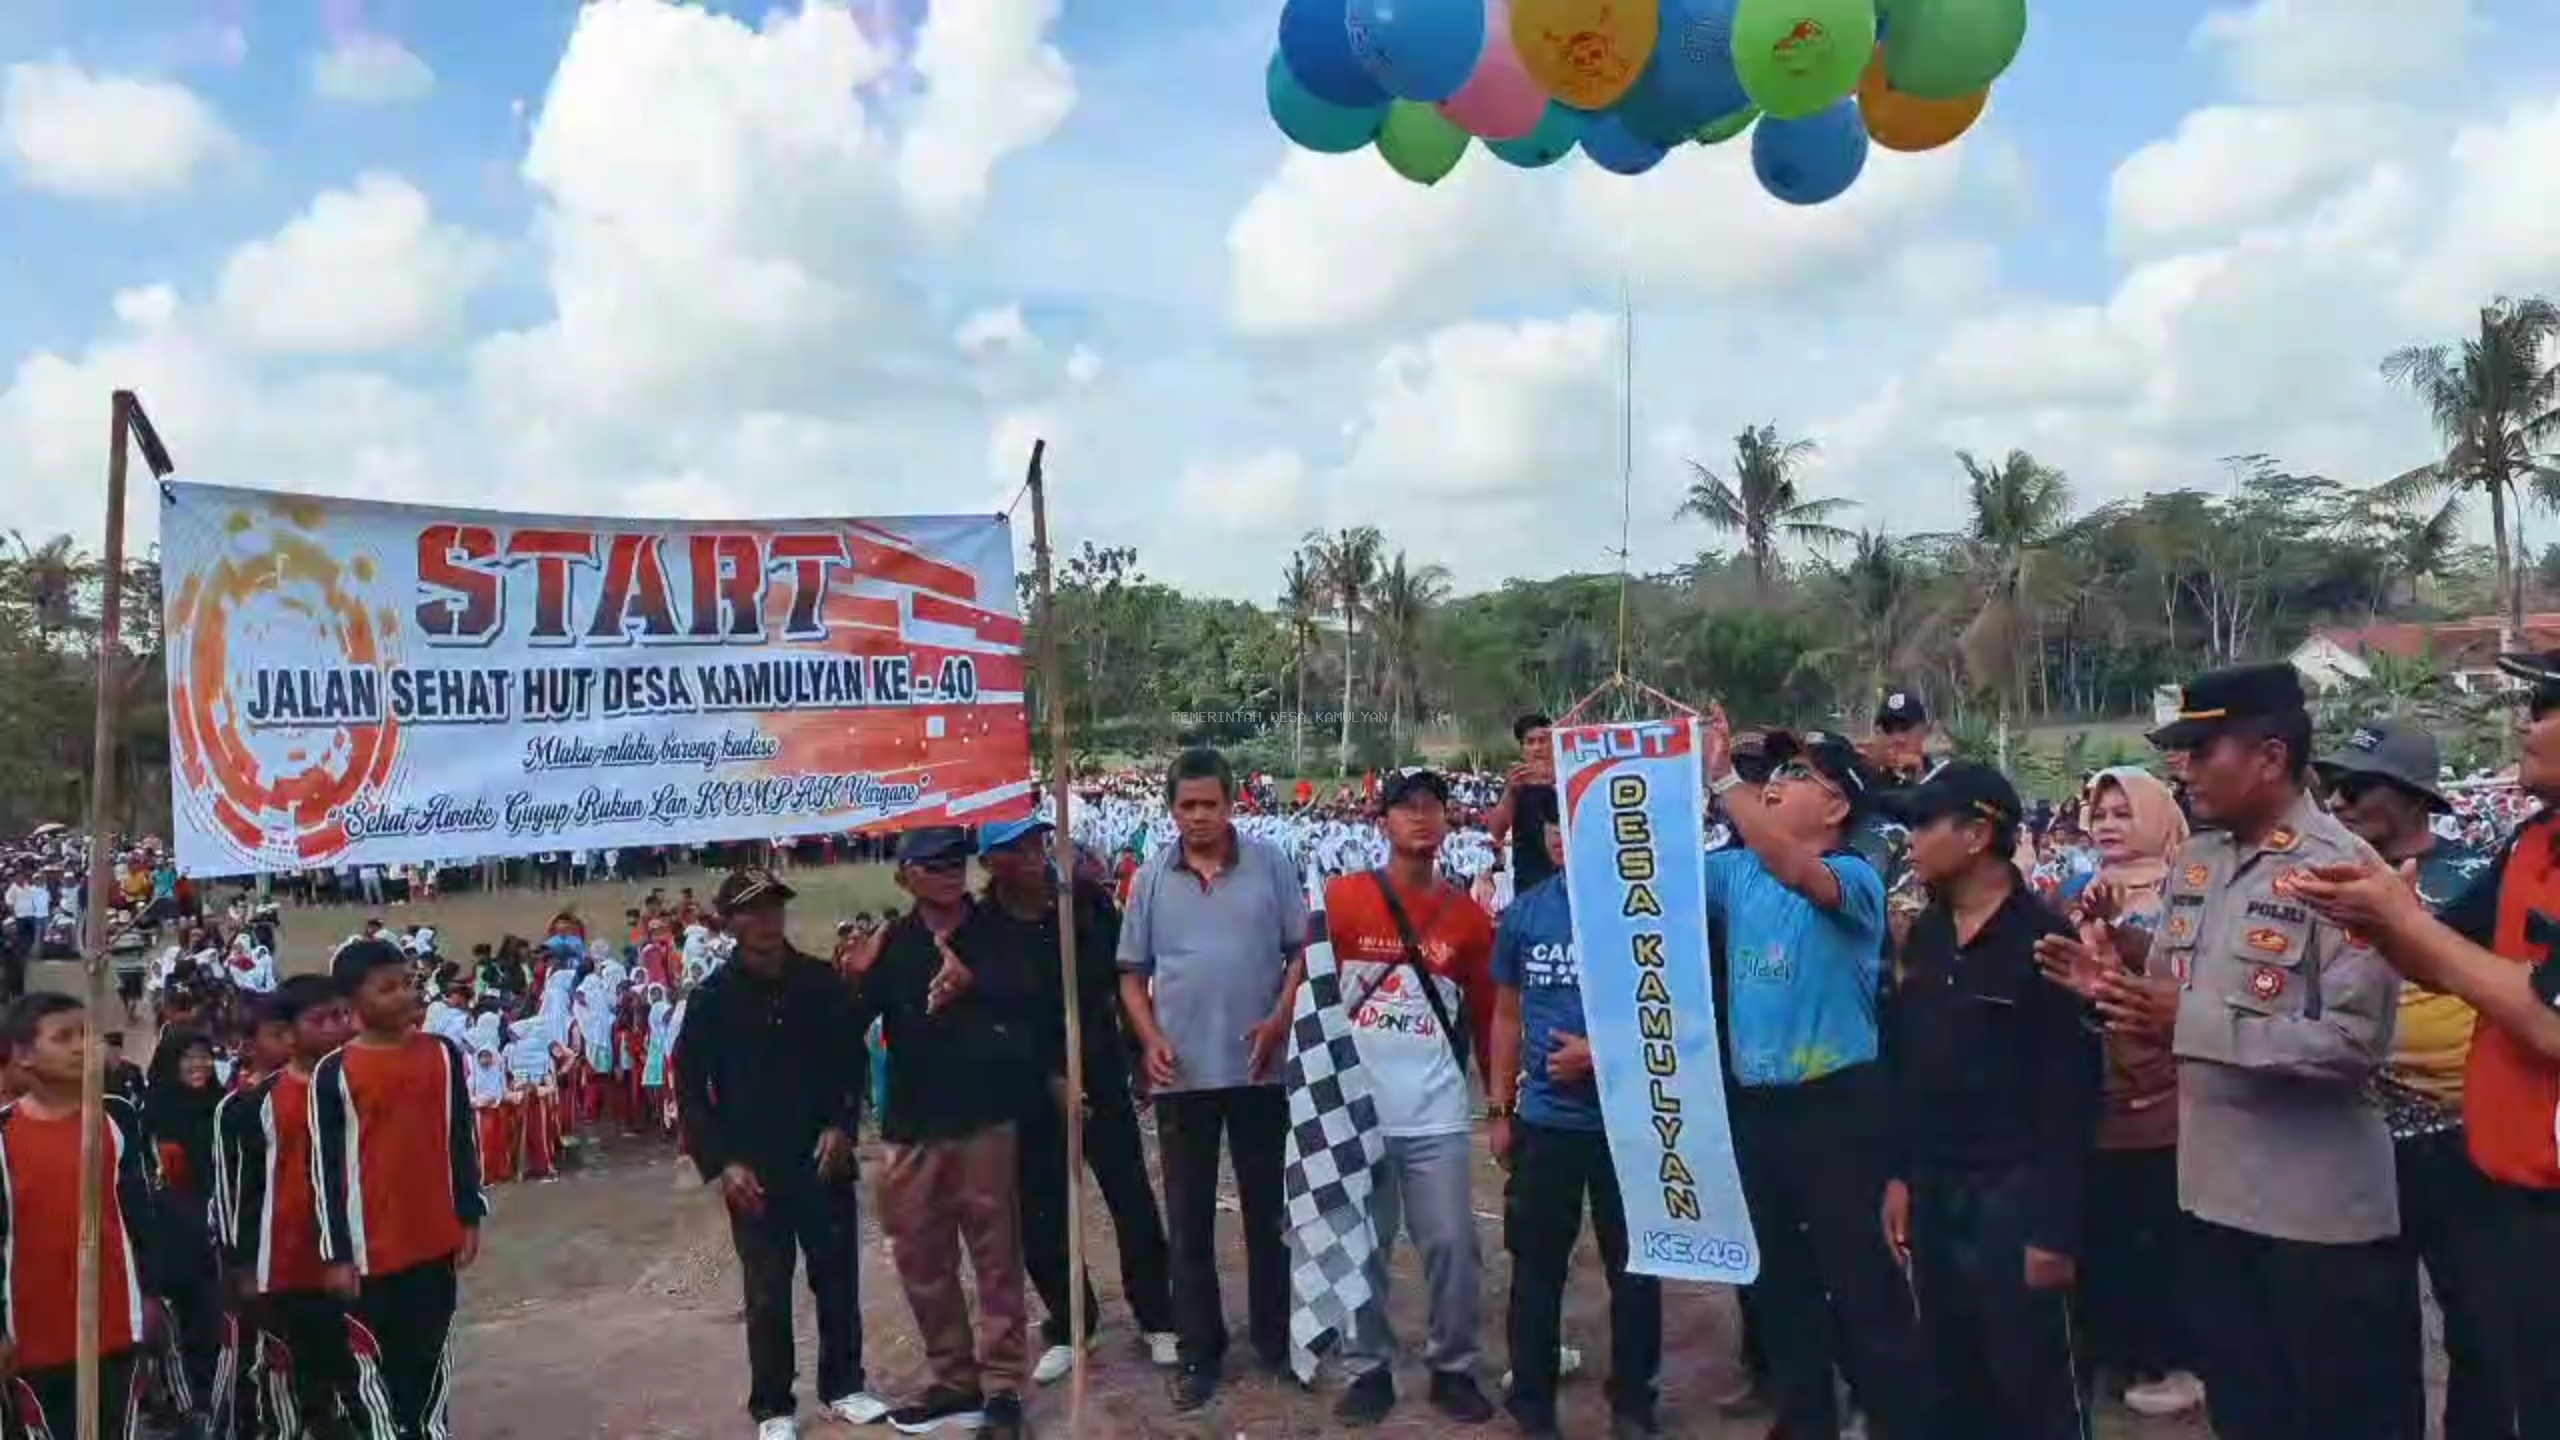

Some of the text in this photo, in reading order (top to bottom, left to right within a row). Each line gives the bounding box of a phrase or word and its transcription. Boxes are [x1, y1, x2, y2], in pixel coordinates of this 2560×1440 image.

[416, 525, 851, 648] START
[248, 667, 383, 728] JALAN
[390, 666, 512, 724] SEHAT
[521, 666, 597, 721] HUT
[602, 664, 696, 716] DESA
[699, 659, 865, 708] KAMULYAN
[871, 656, 912, 704] KE
[938, 656, 977, 702] 40
[658, 729, 718, 771] bareng
[1574, 726, 1678, 762] HUT
[413, 793, 498, 834] Awake
[503, 790, 571, 836] Guyup
[572, 784, 646, 827] Rukun
[648, 782, 692, 825] Lan
[1609, 774, 1661, 918] DESA
[1632, 934, 1701, 1222] KAMULYAN
